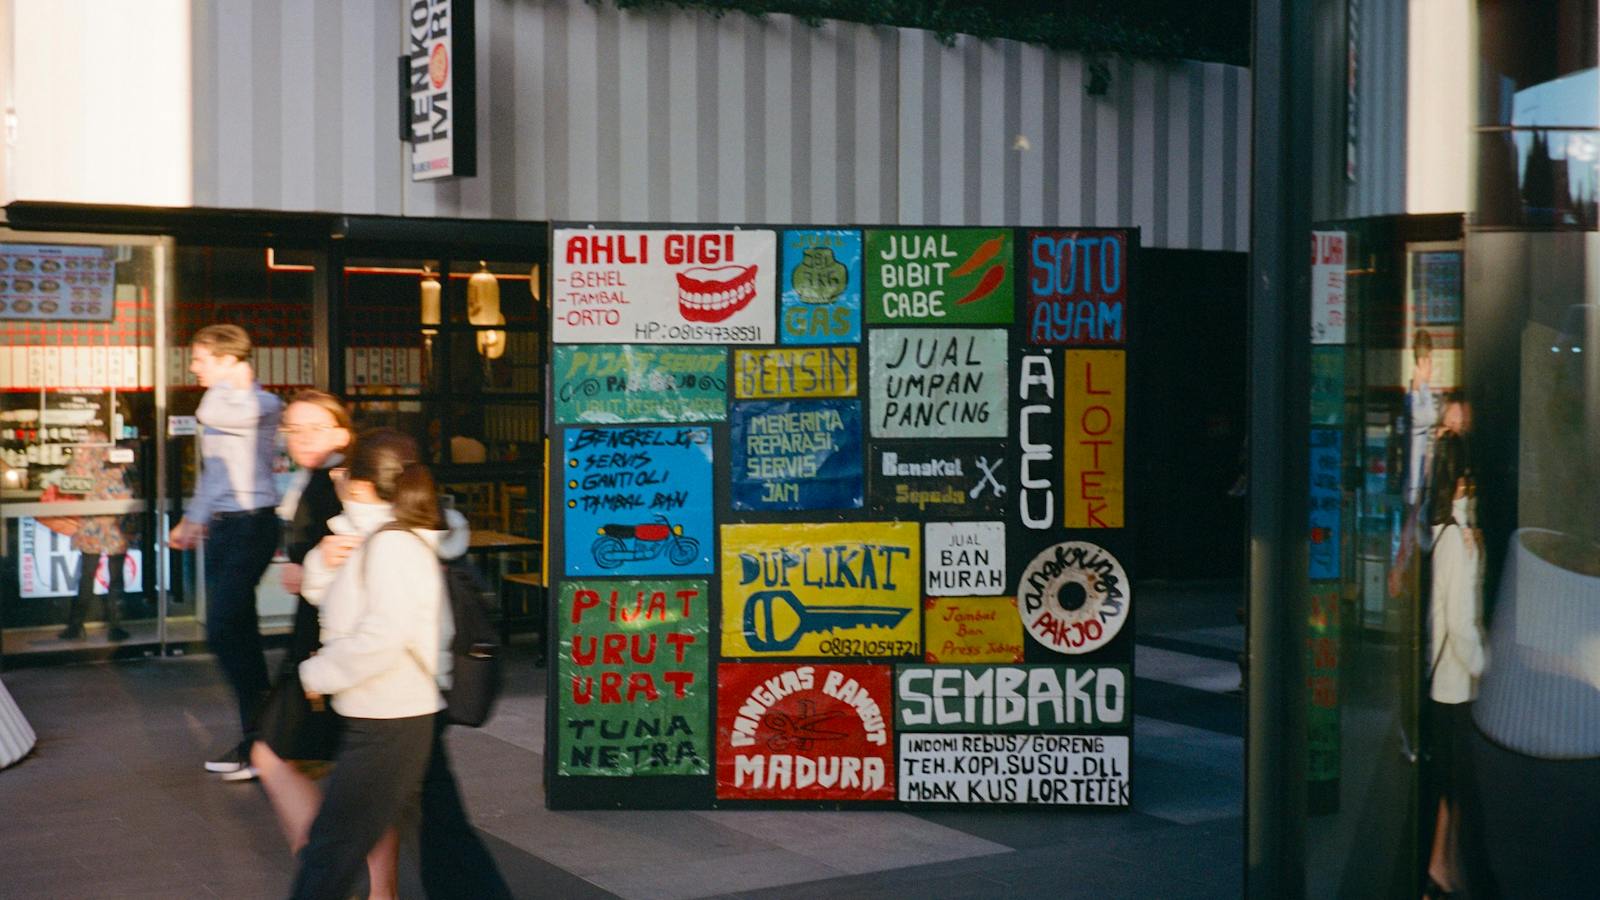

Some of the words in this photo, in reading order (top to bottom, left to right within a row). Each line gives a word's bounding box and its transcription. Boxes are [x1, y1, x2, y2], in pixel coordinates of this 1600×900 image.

[566, 235, 648, 265] AHLI
[664, 234, 734, 265] GIGI
[881, 234, 957, 260] JUAL
[881, 262, 950, 288] BIBIT
[1031, 237, 1120, 296] SOTO
[883, 291, 946, 318] CABE
[785, 306, 850, 336] GAS
[1031, 301, 1123, 341] AYAM
[886, 336, 981, 369] JUAL
[741, 349, 850, 397] BENSIN
[887, 372, 983, 398] UMPAN
[751, 409, 844, 434] MENERIMA
[883, 402, 990, 429] PANCING
[569, 429, 665, 452] BENGKEL
[1020, 355, 1054, 530] ACCU
[1079, 362, 1113, 528] LOTEK
[584, 451, 653, 472] SERVIS
[747, 455, 816, 479] SERVIS
[762, 480, 799, 502] JAM
[949, 535, 980, 547] JUAL
[739, 545, 910, 590] DUPLIKAT
[941, 550, 989, 566] BAN
[929, 570, 1002, 589] MURAH
[572, 589, 698, 623] PIJAT
[572, 633, 696, 666] URUT
[572, 672, 694, 705] URAT
[899, 667, 1125, 726] SEMBAKO
[731, 666, 815, 747] PANGKAS
[822, 670, 887, 746] RAMBUT
[568, 716, 693, 739] TUNA
[569, 741, 700, 768] NETRA
[909, 739, 957, 752] INDOMI
[735, 754, 885, 791] MADURA
[968, 778, 1018, 802] KUS
